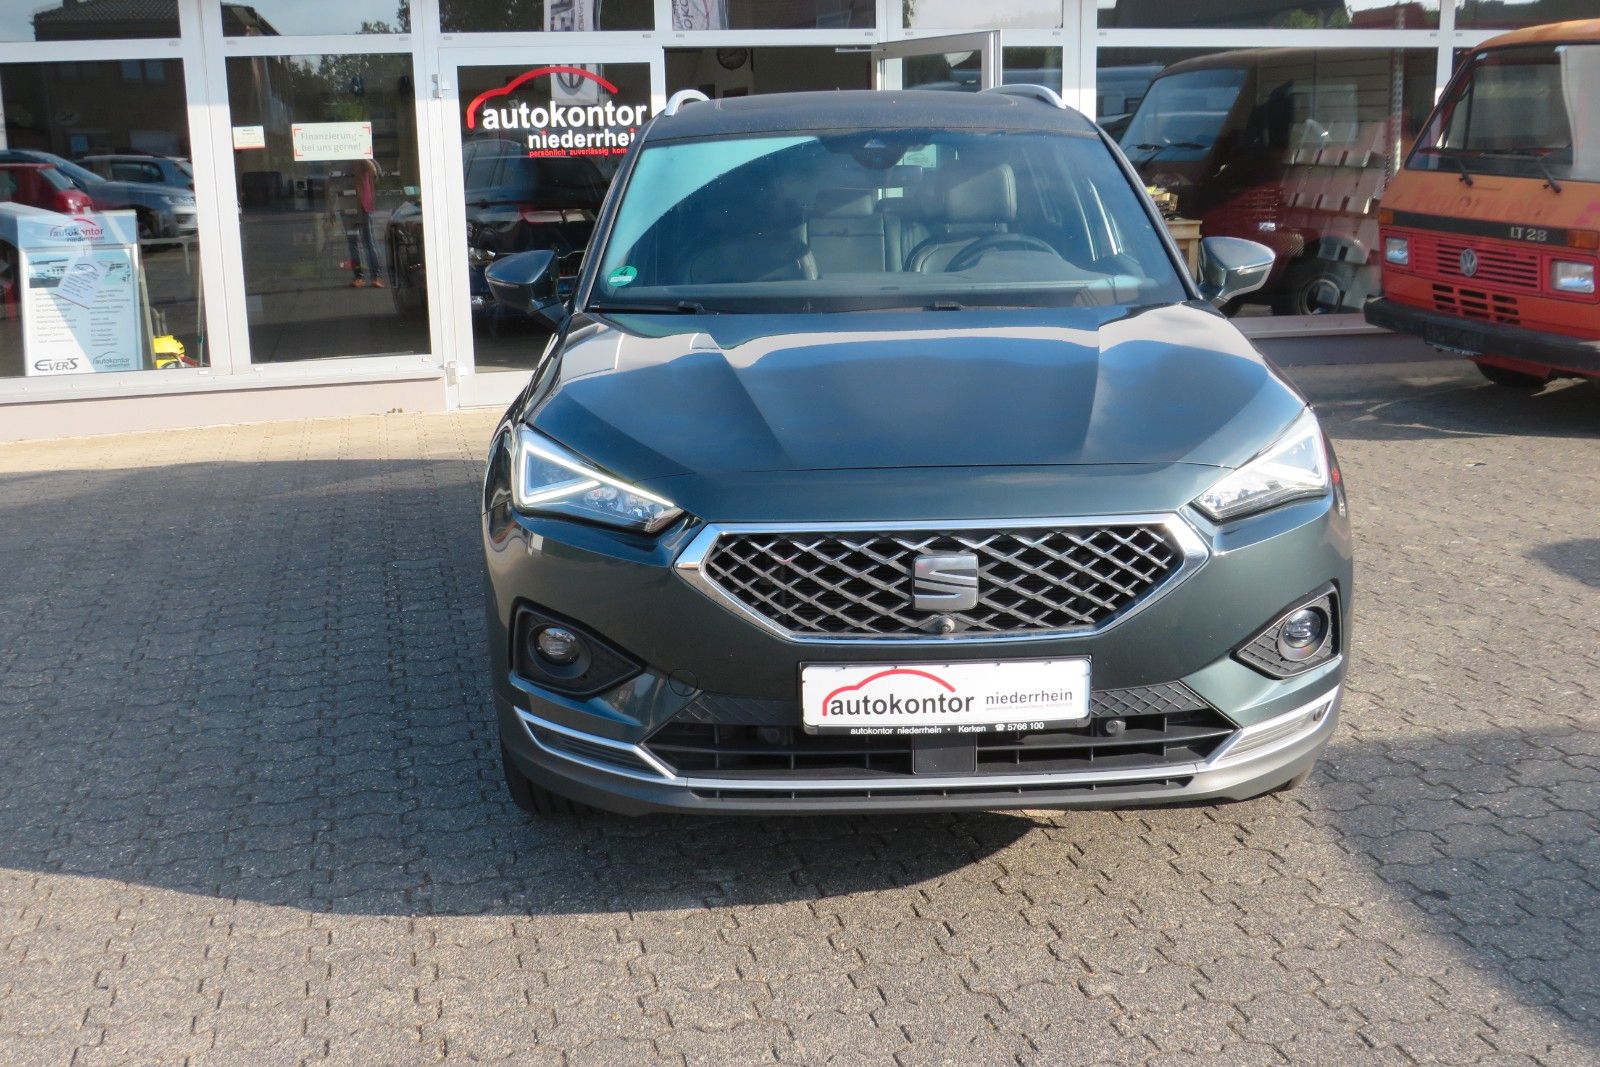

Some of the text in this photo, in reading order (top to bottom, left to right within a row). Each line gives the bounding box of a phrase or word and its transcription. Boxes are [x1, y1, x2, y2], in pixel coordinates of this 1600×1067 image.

[482, 100, 647, 130] autokontor
[301, 132, 357, 142] Finanzierung
[527, 127, 636, 150] niederrhei
[301, 142, 361, 153] bei uns gerne!
[529, 149, 566, 158] persönlich
[569, 147, 608, 156] zuverlässig
[1510, 226, 1548, 242] LT 28
[830, 693, 975, 716] autokontor
[985, 688, 1074, 705] niederrhein
[850, 721, 1044, 735] autokontor niederrhein Kerken 5766 100
